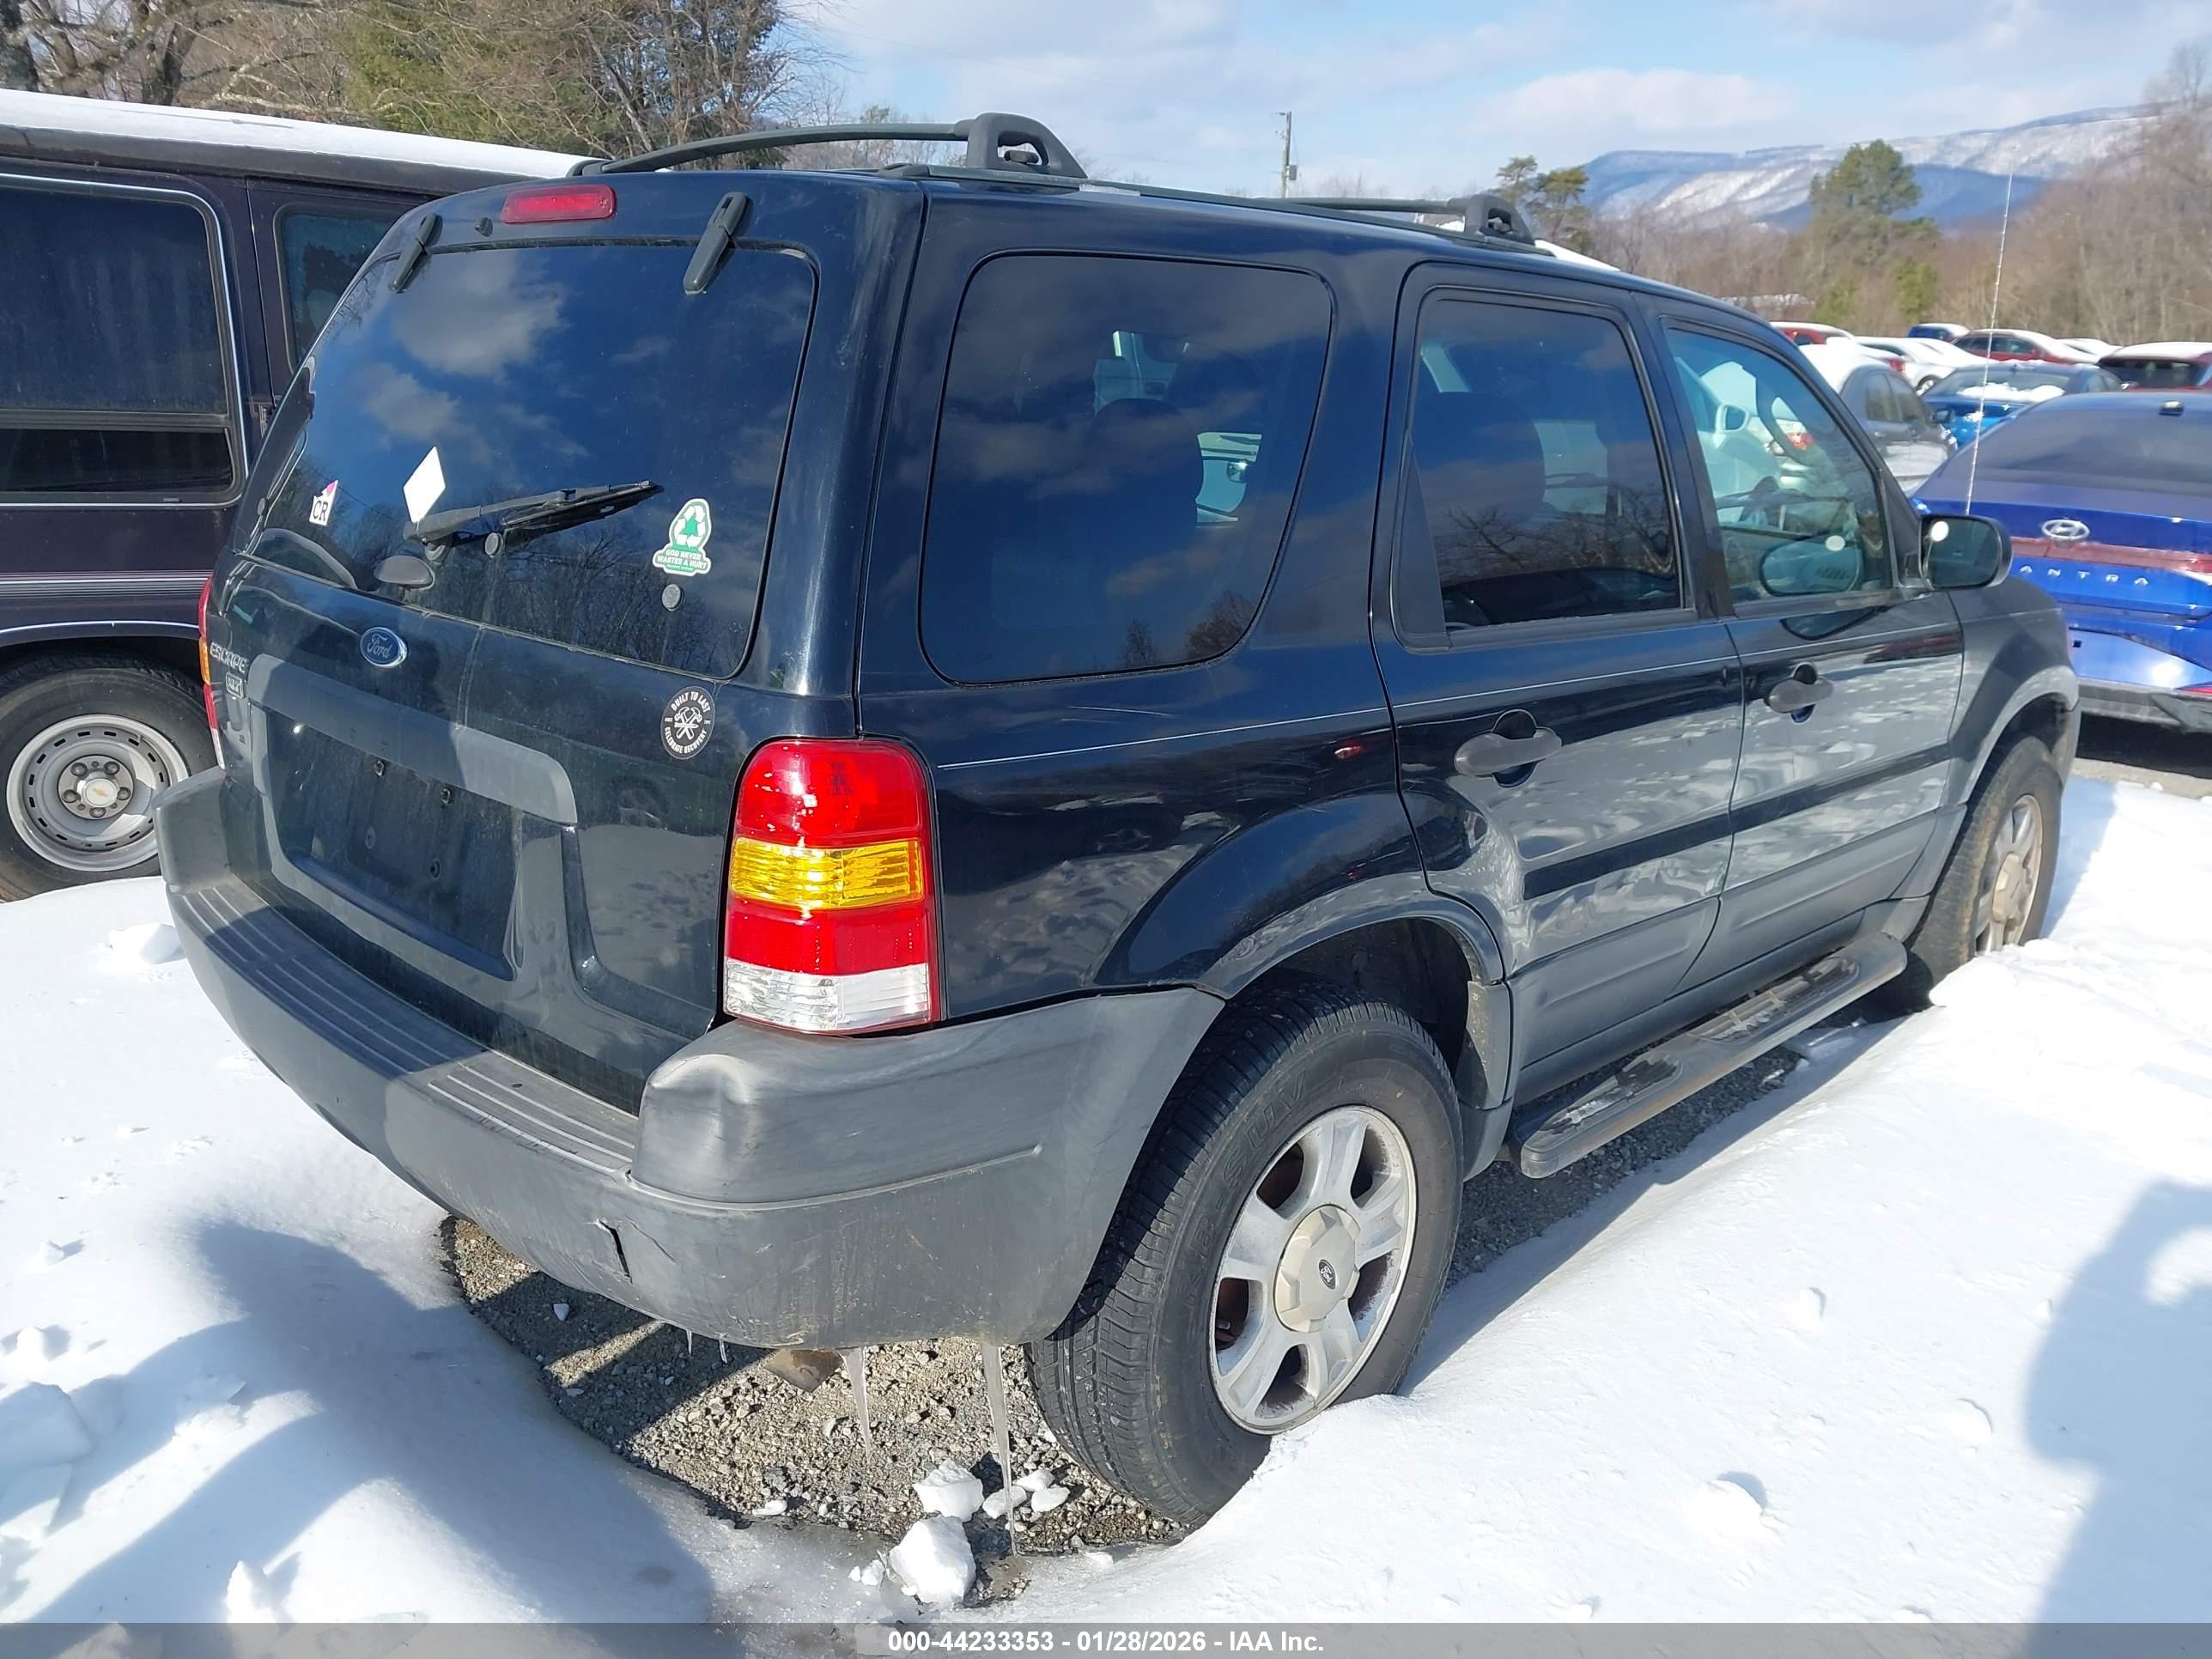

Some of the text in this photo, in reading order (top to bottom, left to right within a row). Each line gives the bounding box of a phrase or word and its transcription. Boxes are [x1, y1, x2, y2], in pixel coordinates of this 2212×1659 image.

[313, 500, 329, 521] CR
[210, 641, 247, 673] ESCAPE
[366, 634, 393, 659] Ford
[671, 690, 711, 713] BUILT TO LAST
[664, 726, 708, 754] CELEBRATE RECOVERY
[1320, 1265, 1333, 1283] Ford
